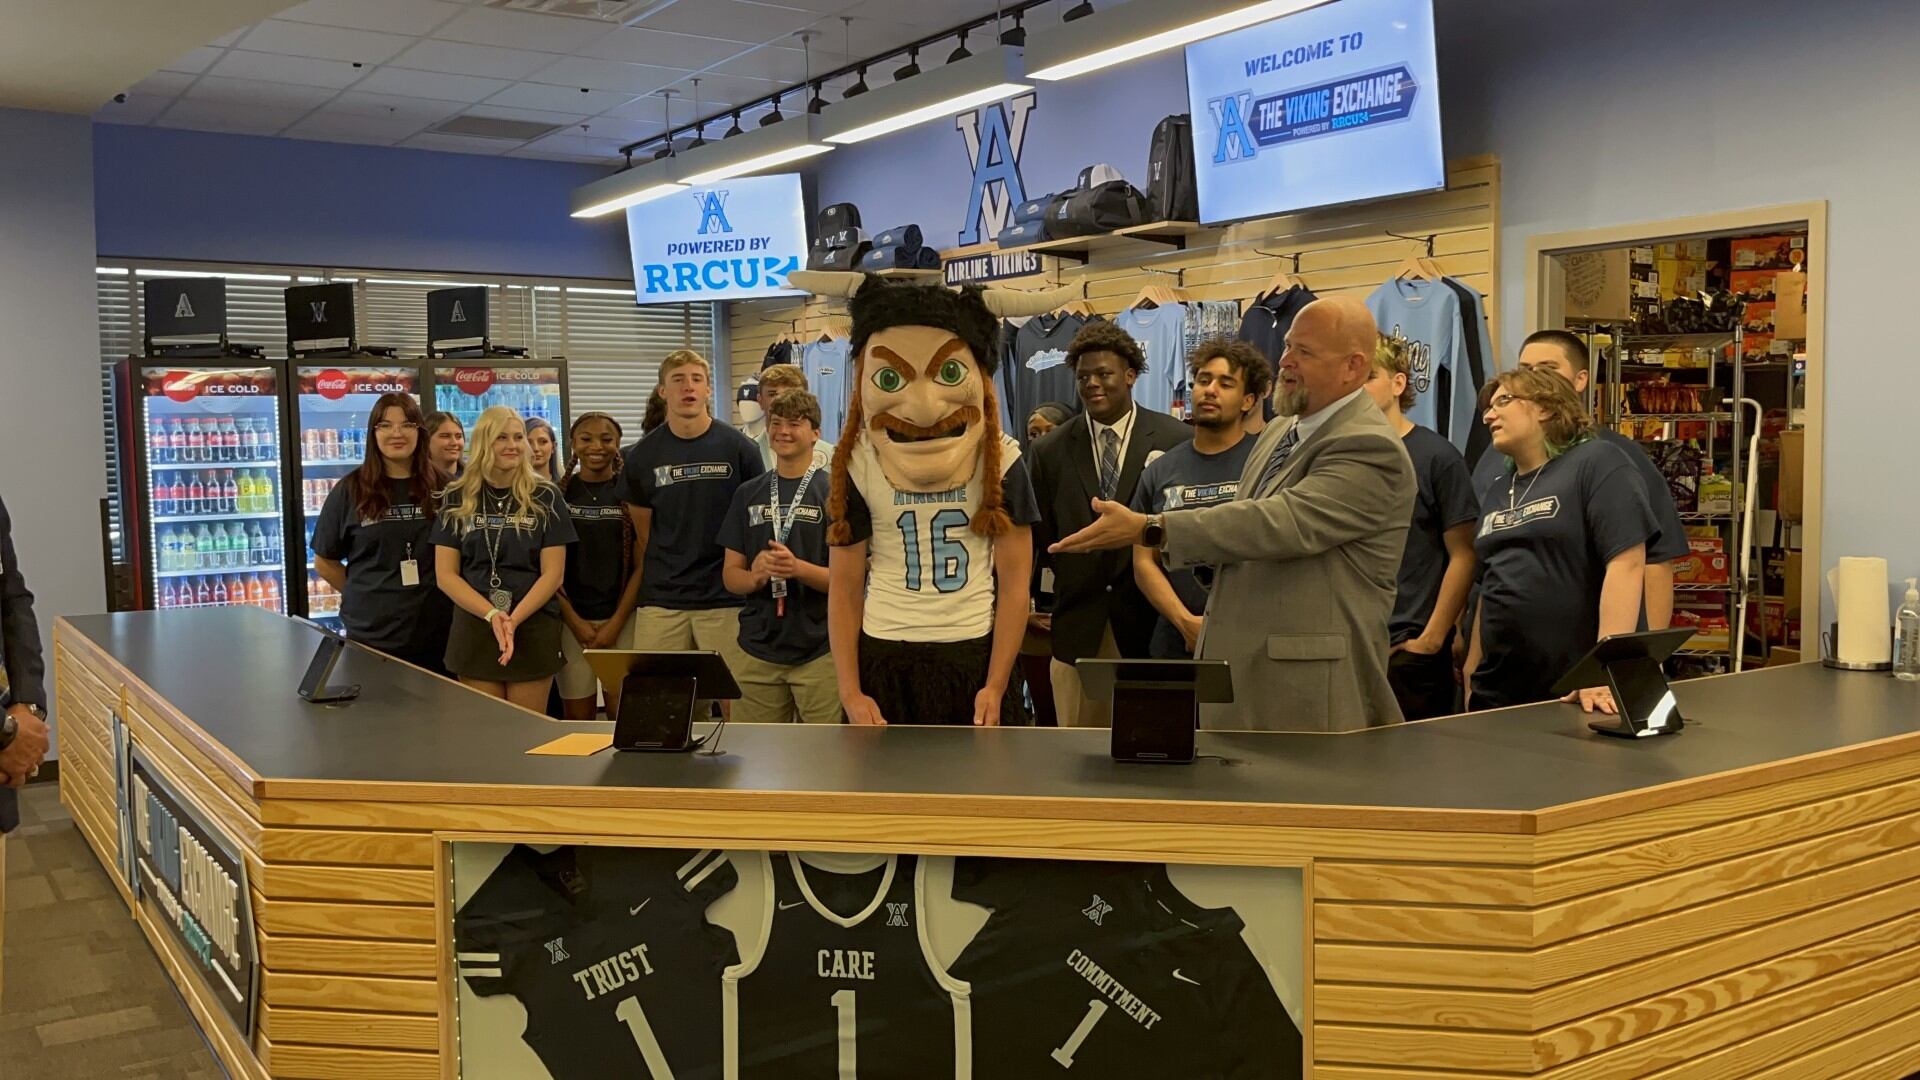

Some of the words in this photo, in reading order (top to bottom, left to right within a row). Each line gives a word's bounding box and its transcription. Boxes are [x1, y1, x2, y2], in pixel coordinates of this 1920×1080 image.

[1244, 39, 1334, 77] WELCOME
[1339, 31, 1363, 54] TO
[1258, 99, 1283, 131] THE
[1285, 89, 1329, 125] VIKING
[1332, 72, 1404, 116] EXCHANGE
[1292, 123, 1320, 137] POWERED
[1321, 121, 1330, 131] BY
[667, 238, 745, 256] POWERED
[749, 237, 771, 250] BY
[947, 257, 989, 283] AIRLINE
[991, 251, 1037, 276] VIKINGS
[205, 385, 225, 394] ICE
[228, 385, 259, 394] COLD
[354, 383, 374, 392] ICE
[376, 383, 404, 392] COLD
[455, 369, 490, 382] Coca-Cola
[496, 372, 512, 381] ICE
[514, 372, 539, 380] COLD
[1185, 488, 1197, 498] THE
[896, 508, 970, 594] 16
[178, 826, 240, 971] EXCHANGE
[572, 943, 654, 1000] TRUST
[817, 949, 875, 980] CARE
[1066, 948, 1161, 1030] COMMITMENT
[615, 995, 676, 1080] 1
[831, 989, 857, 1080] 1
[1050, 999, 1109, 1069] 1
